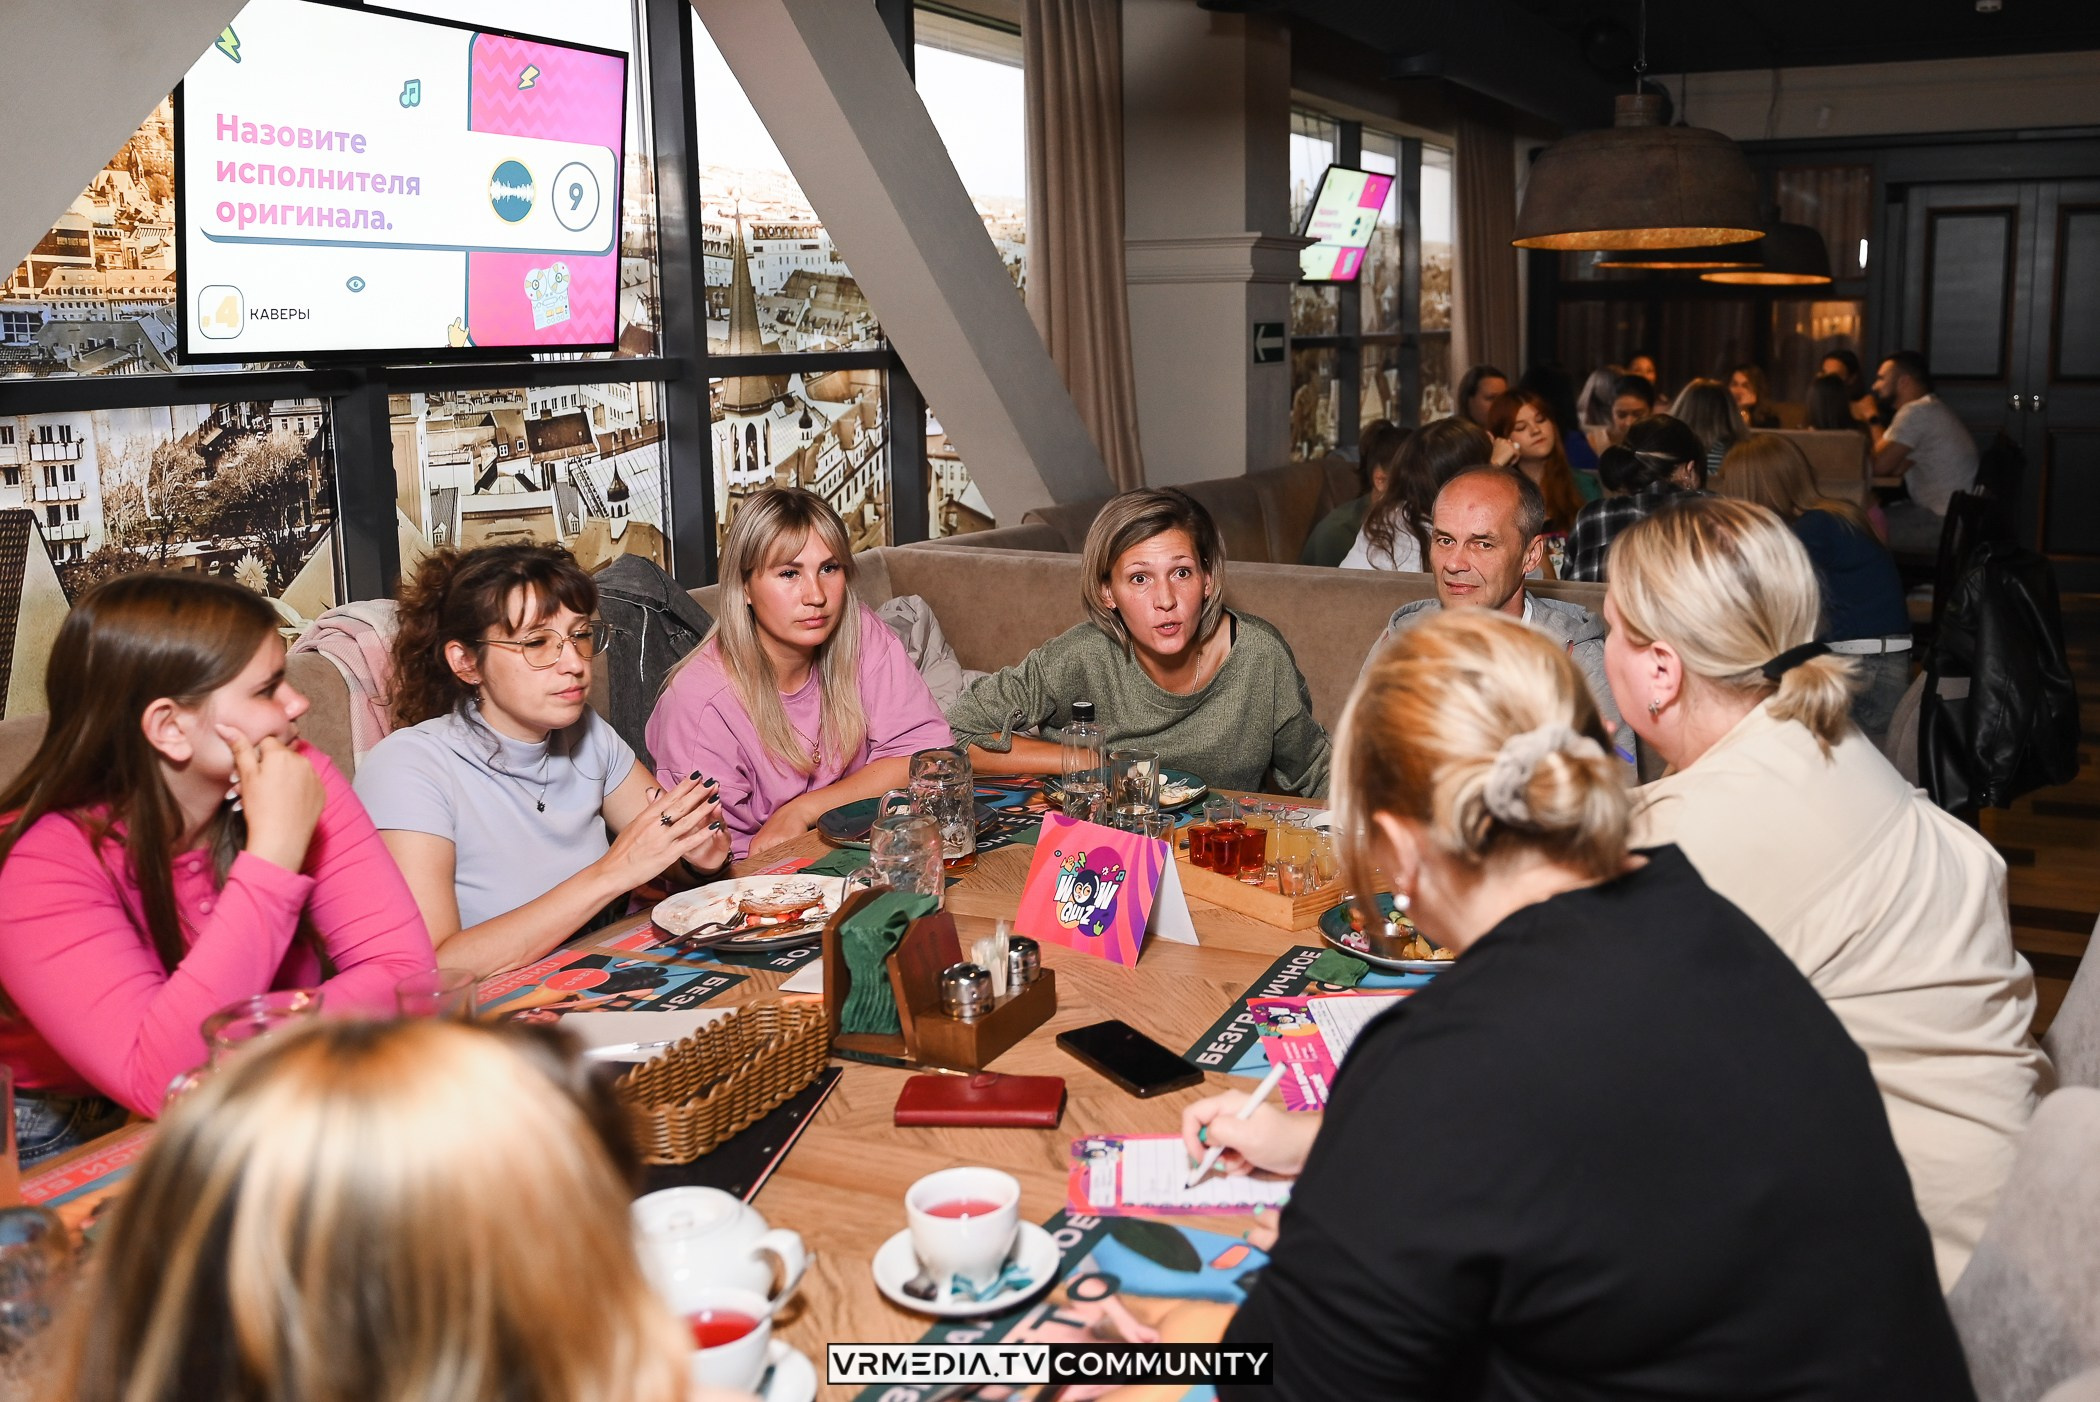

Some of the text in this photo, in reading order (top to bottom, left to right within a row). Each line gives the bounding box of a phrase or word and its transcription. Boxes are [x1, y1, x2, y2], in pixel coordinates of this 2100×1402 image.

[215, 113, 367, 154] Назовите
[215, 160, 421, 196] исполнителя
[568, 182, 584, 211] 9
[215, 200, 394, 230] оригинала.
[250, 308, 310, 320] КАВЕРЫ
[1060, 902, 1096, 926] QUIZ
[1196, 950, 1321, 1066] БЕЗГРИЧНОЕ
